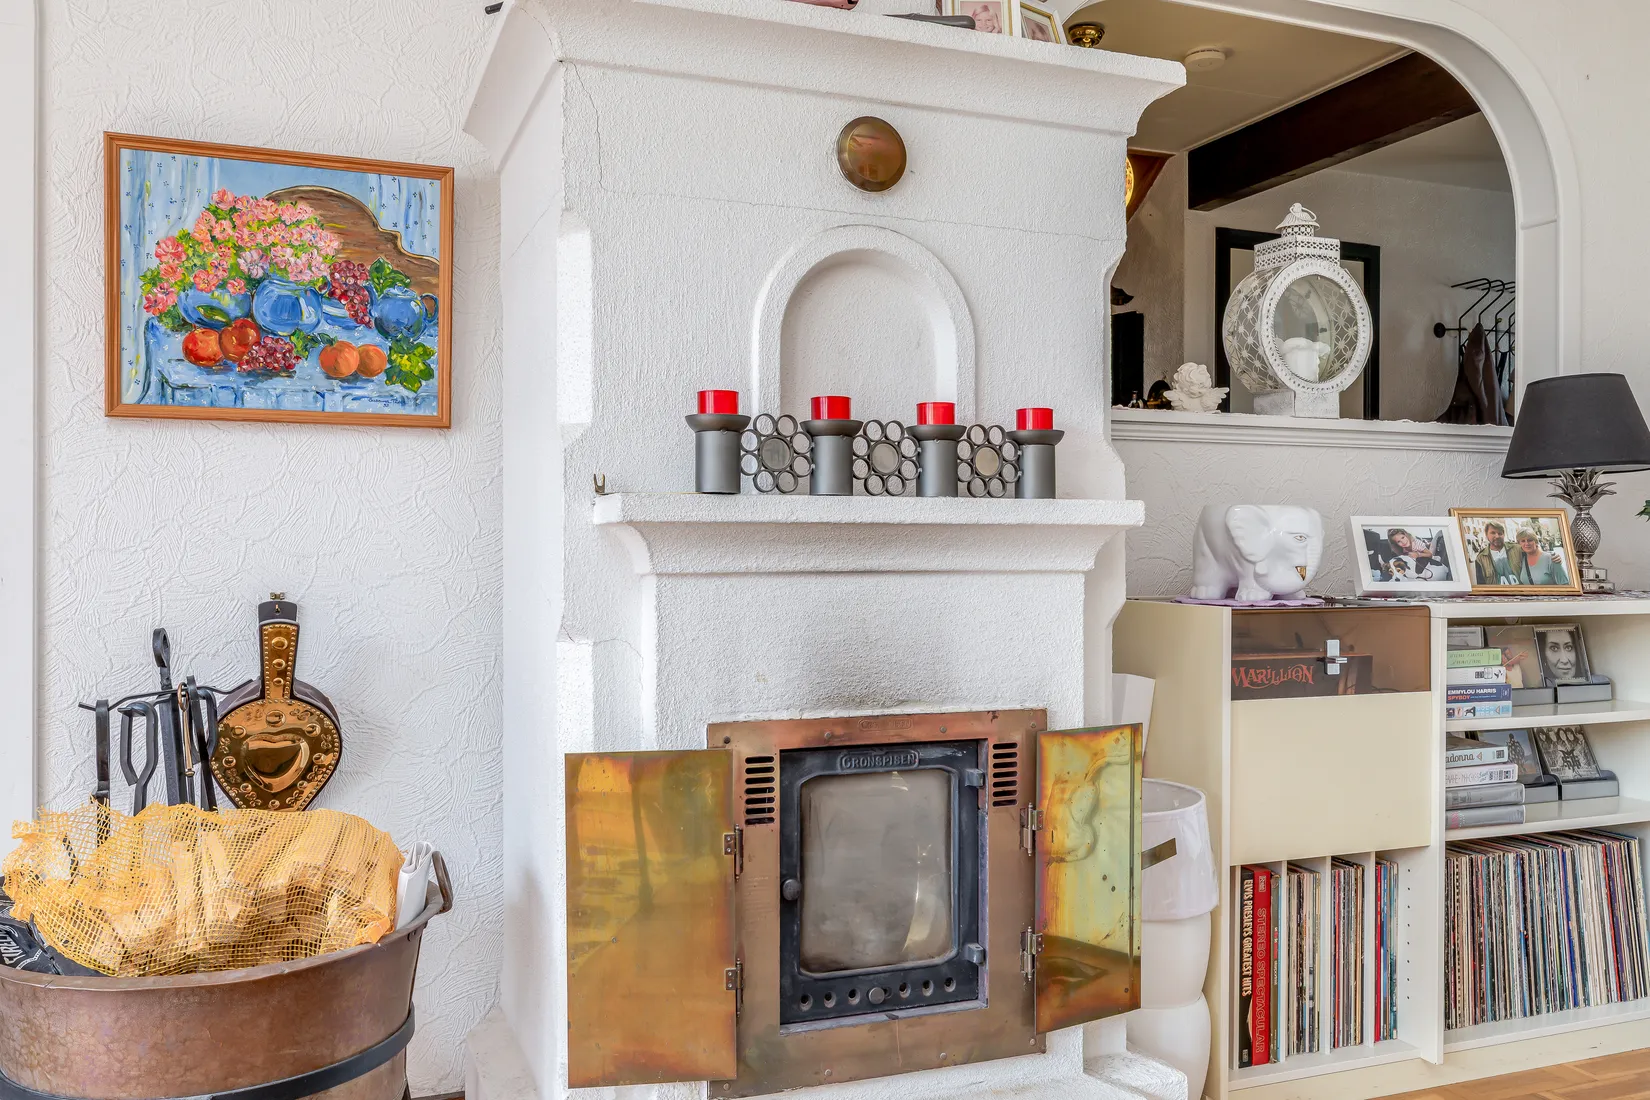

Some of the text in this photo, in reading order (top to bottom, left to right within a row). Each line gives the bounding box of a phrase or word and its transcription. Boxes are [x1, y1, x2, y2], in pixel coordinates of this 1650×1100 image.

[1446, 753, 1475, 763] adonna
[1241, 879, 1253, 997] ELVIS PRESLEY'S GREATEST HITS
[1255, 908, 1267, 1053] STEREO SPECTACULAR
